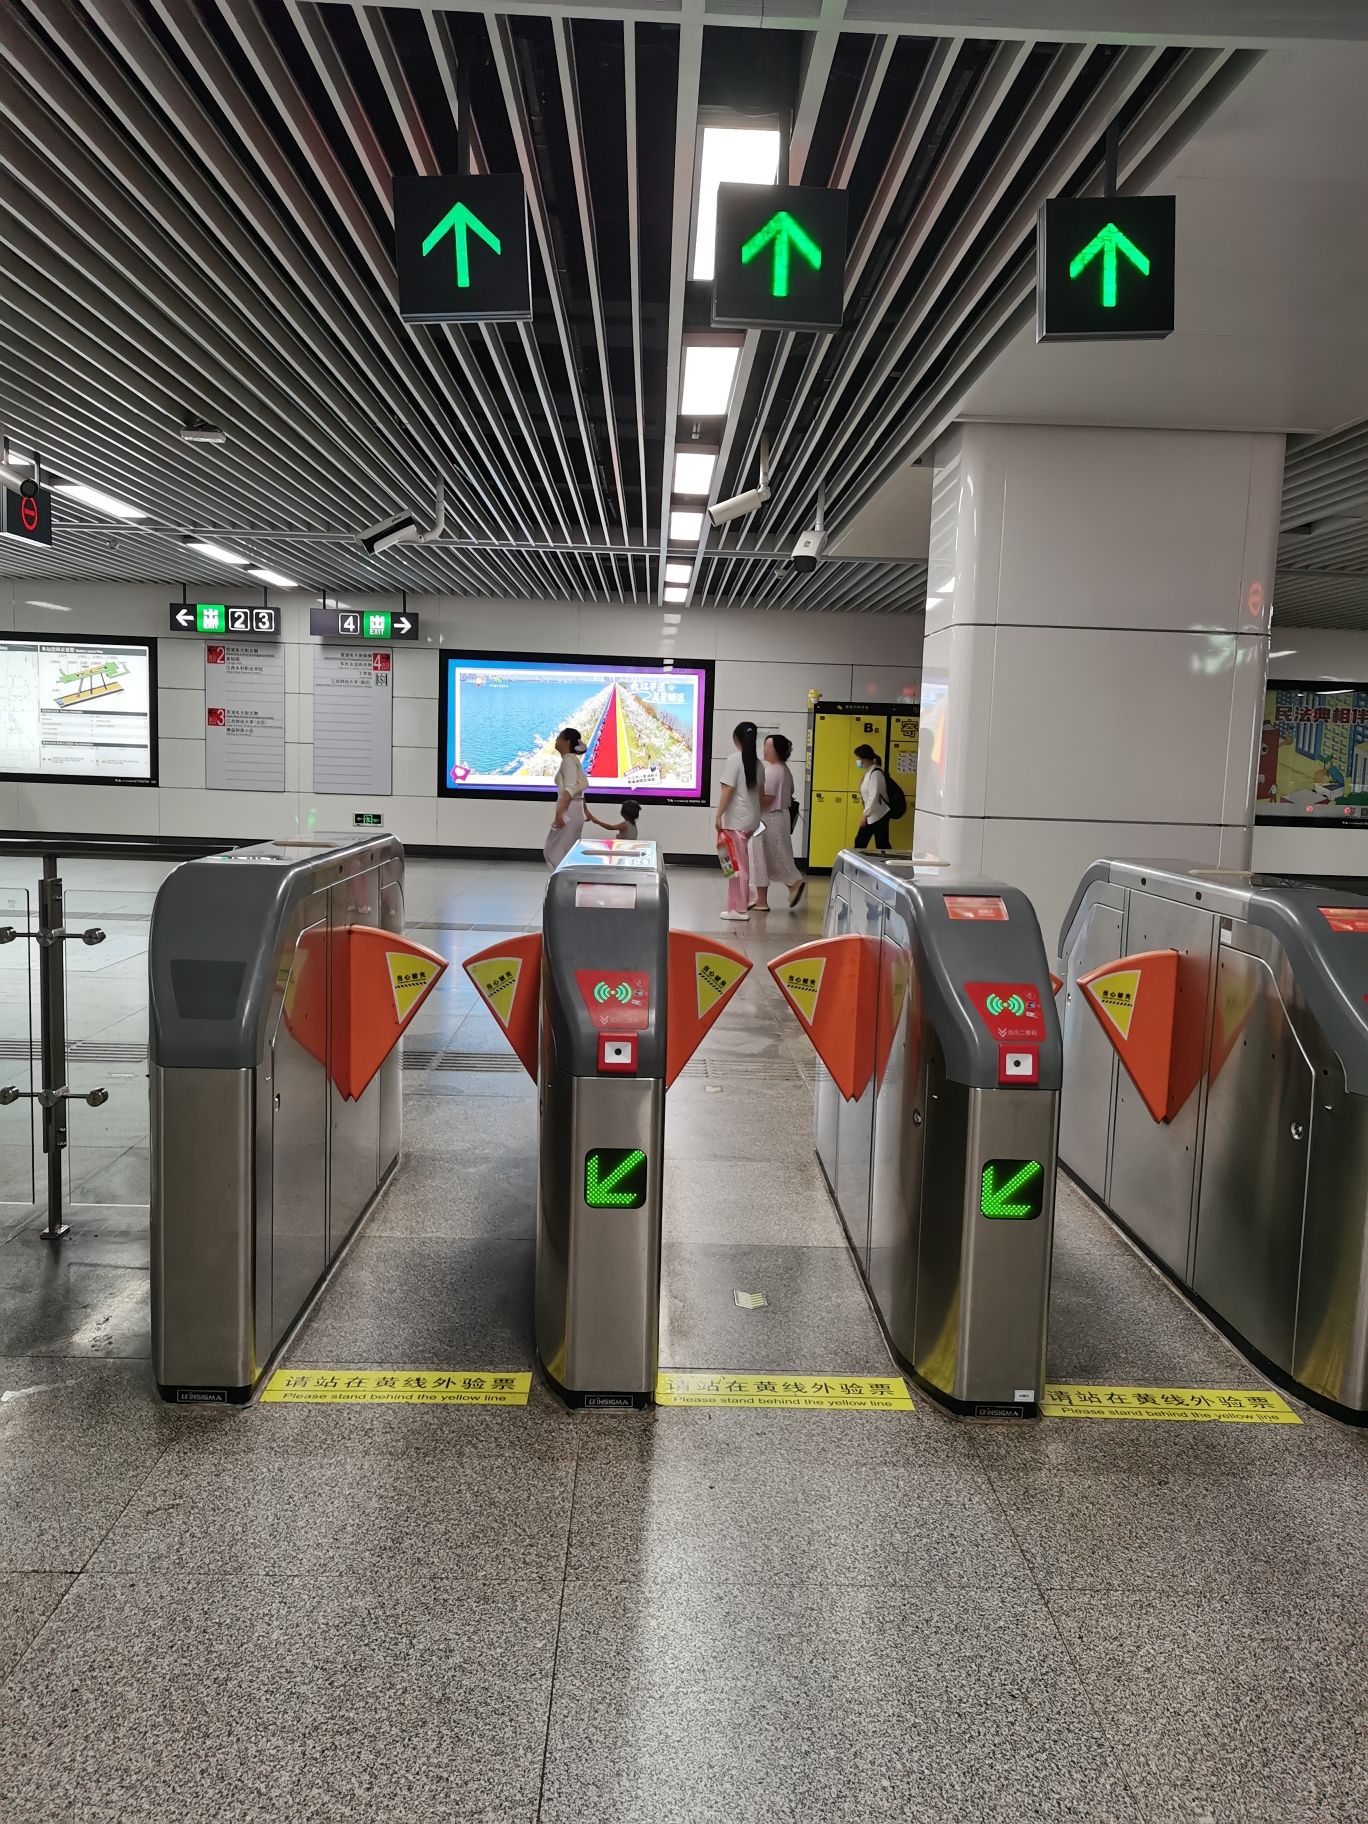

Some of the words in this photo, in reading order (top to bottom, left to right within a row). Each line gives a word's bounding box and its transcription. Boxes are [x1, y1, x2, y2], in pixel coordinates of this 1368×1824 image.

[234, 611, 246, 628] 2
[258, 612, 270, 630] 3
[343, 615, 355, 632] 4
[217, 646, 225, 664] 2
[373, 653, 382, 671] 4
[217, 709, 225, 726] 3
[397, 971, 426, 982] 当心被夹
[788, 975, 816, 986] 当心被夹
[1102, 990, 1131, 1000] 当心被夹
[284, 1376, 517, 1391] 请站在黄线外验票
[667, 1379, 896, 1396] 请站在黄线外验票
[370, 1393, 414, 1401] behind
[417, 1393, 437, 1401] the
[439, 1394, 480, 1403] yellow
[484, 1394, 507, 1402] line
[720, 1396, 755, 1404] stand
[758, 1397, 802, 1405] behind
[804, 1398, 824, 1406] the
[826, 1399, 867, 1408] yellow
[870, 1399, 893, 1407] line
[1046, 1390, 1275, 1409] 请站在黄线外验票
[1061, 1406, 1105, 1415] Please
[1108, 1408, 1143, 1416] stand
[1146, 1409, 1189, 1418] behind
[1191, 1411, 1211, 1419] the
[1213, 1412, 1254, 1422] yellow
[1257, 1413, 1280, 1422] line
